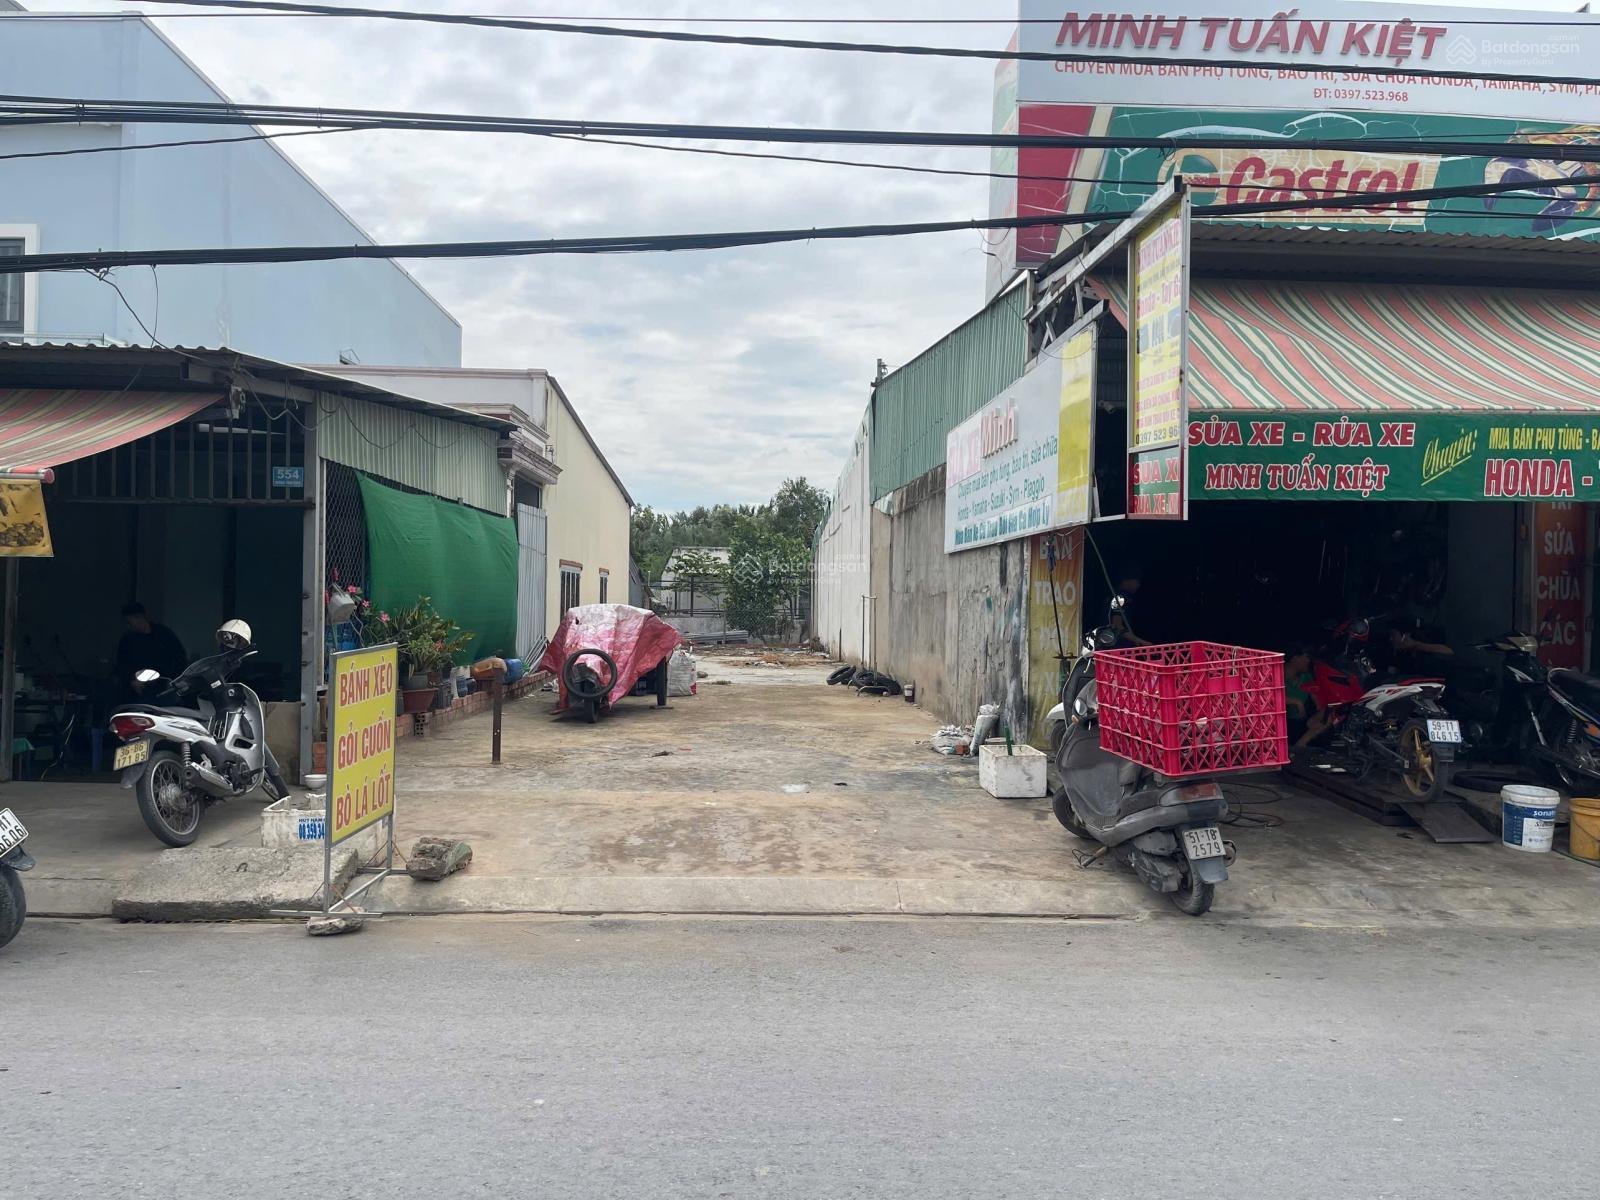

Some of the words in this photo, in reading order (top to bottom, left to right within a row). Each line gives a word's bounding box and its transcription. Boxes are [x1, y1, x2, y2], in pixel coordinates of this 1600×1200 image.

[1055, 12, 1187, 49] MINH
[1200, 9, 1331, 54] TUẤN
[1341, 18, 1447, 67] KIỆT
[1313, 87, 1332, 99] ĐT:
[1334, 89, 1409, 102] 0397.523.968
[1226, 157, 1420, 215] Castrol
[981, 398, 1018, 460] Minh
[1153, 428, 1167, 441] 523
[1168, 426, 1179, 438] 96
[1188, 415, 1243, 446] SỬA
[1248, 422, 1286, 446] XE
[1313, 416, 1373, 447] RỬA
[1378, 423, 1416, 447] XE
[1488, 427, 1510, 450] MUA
[1512, 423, 1533, 450] BÁN
[1535, 427, 1556, 455] PHỤ
[276, 468, 300, 481] 554
[1204, 464, 1263, 490] MINH
[1266, 453, 1331, 491] TUẤN
[1333, 457, 1390, 497] KIỆT
[1484, 458, 1575, 497] HONDA
[1544, 522, 1575, 555] SỬA
[1034, 581, 1077, 606] TRAO
[1536, 570, 1581, 601] CHỮA
[340, 661, 370, 707] BÁNH
[373, 656, 393, 695] XÈO
[337, 722, 358, 769] GỎI
[361, 711, 391, 760] CUỐN
[335, 784, 351, 830] BÒ
[355, 776, 368, 820] LÁ
[371, 762, 391, 810] LỐT
[1193, 841, 1222, 858] 2579
